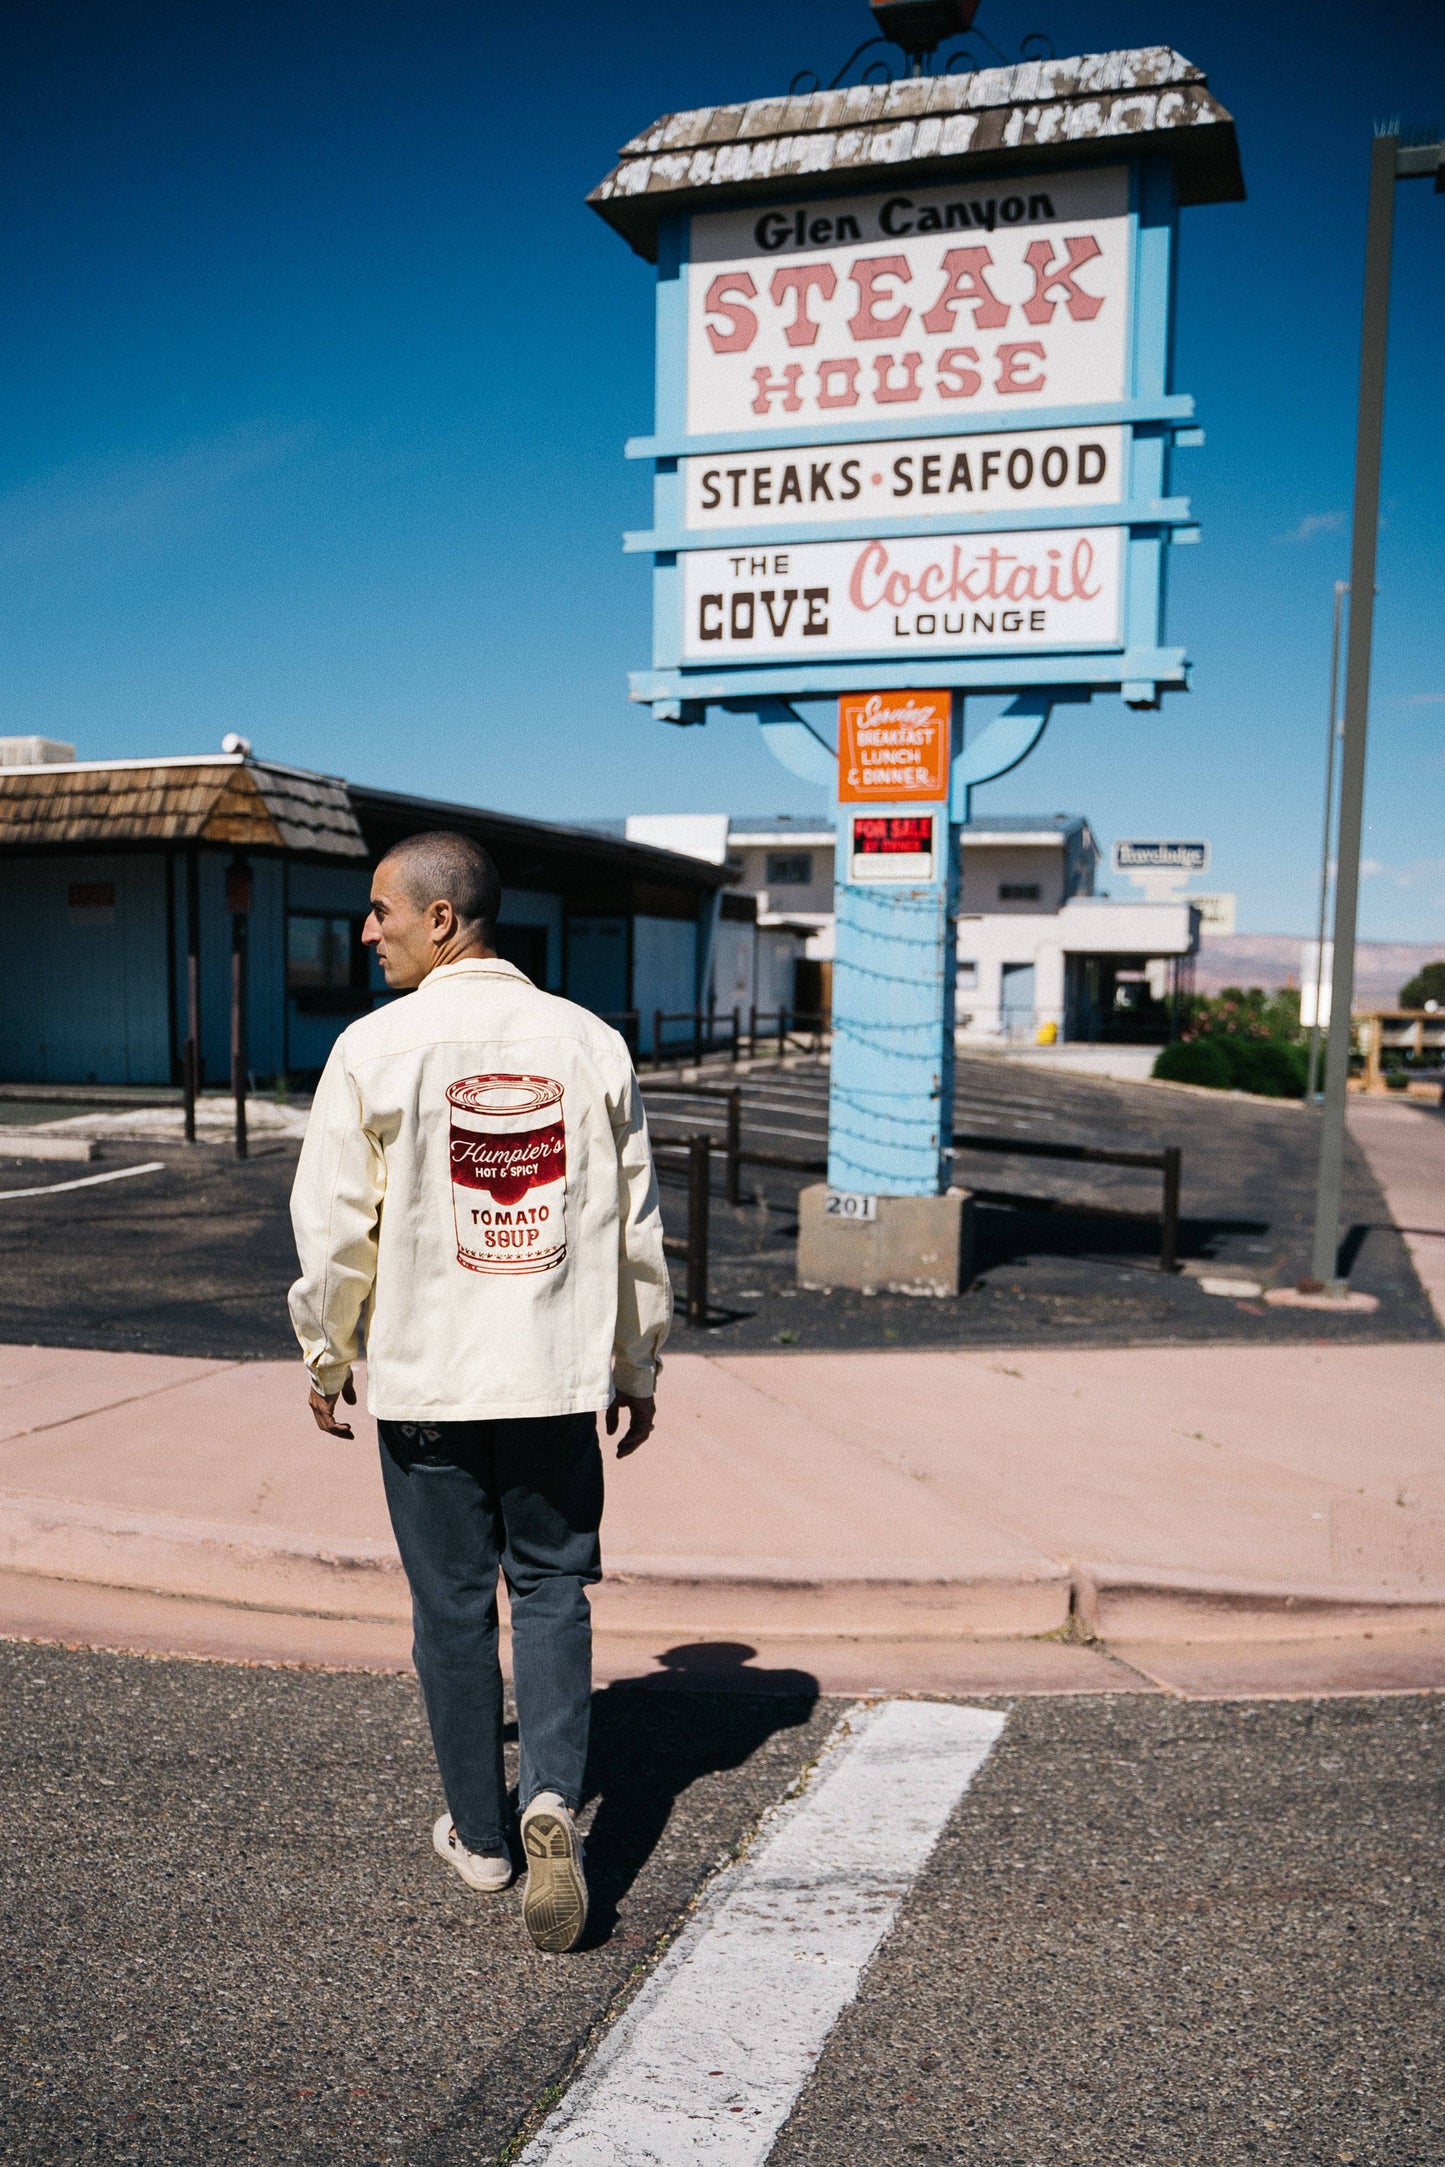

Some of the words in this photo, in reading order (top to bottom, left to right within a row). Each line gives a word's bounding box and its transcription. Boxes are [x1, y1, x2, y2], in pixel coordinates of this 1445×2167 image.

[755, 211, 861, 252] Glen
[879, 192, 1055, 232] Canyon
[705, 235, 1105, 354] STEAK
[751, 341, 1046, 414] HOUSE
[701, 460, 861, 509] STEAKS
[893, 444, 1107, 496] SEAFOOD
[729, 555, 790, 577] THE
[849, 537, 1102, 612] Cocktail
[699, 587, 829, 640] COVE
[895, 610, 1046, 636] LOUNGE
[856, 694, 936, 729] Serving
[857, 728, 935, 747] BREAKFAST
[861, 749, 921, 766] LUNCH
[863, 766, 932, 786] DINNER
[450, 1137, 565, 1169] Humpier's
[475, 1166, 497, 1178] HOT
[500, 1167, 508, 1178] &
[510, 1163, 539, 1177] SPICY
[471, 1205, 550, 1226] TOMATO
[826, 1196, 869, 1217] 201
[484, 1228, 540, 1248] SOUP
